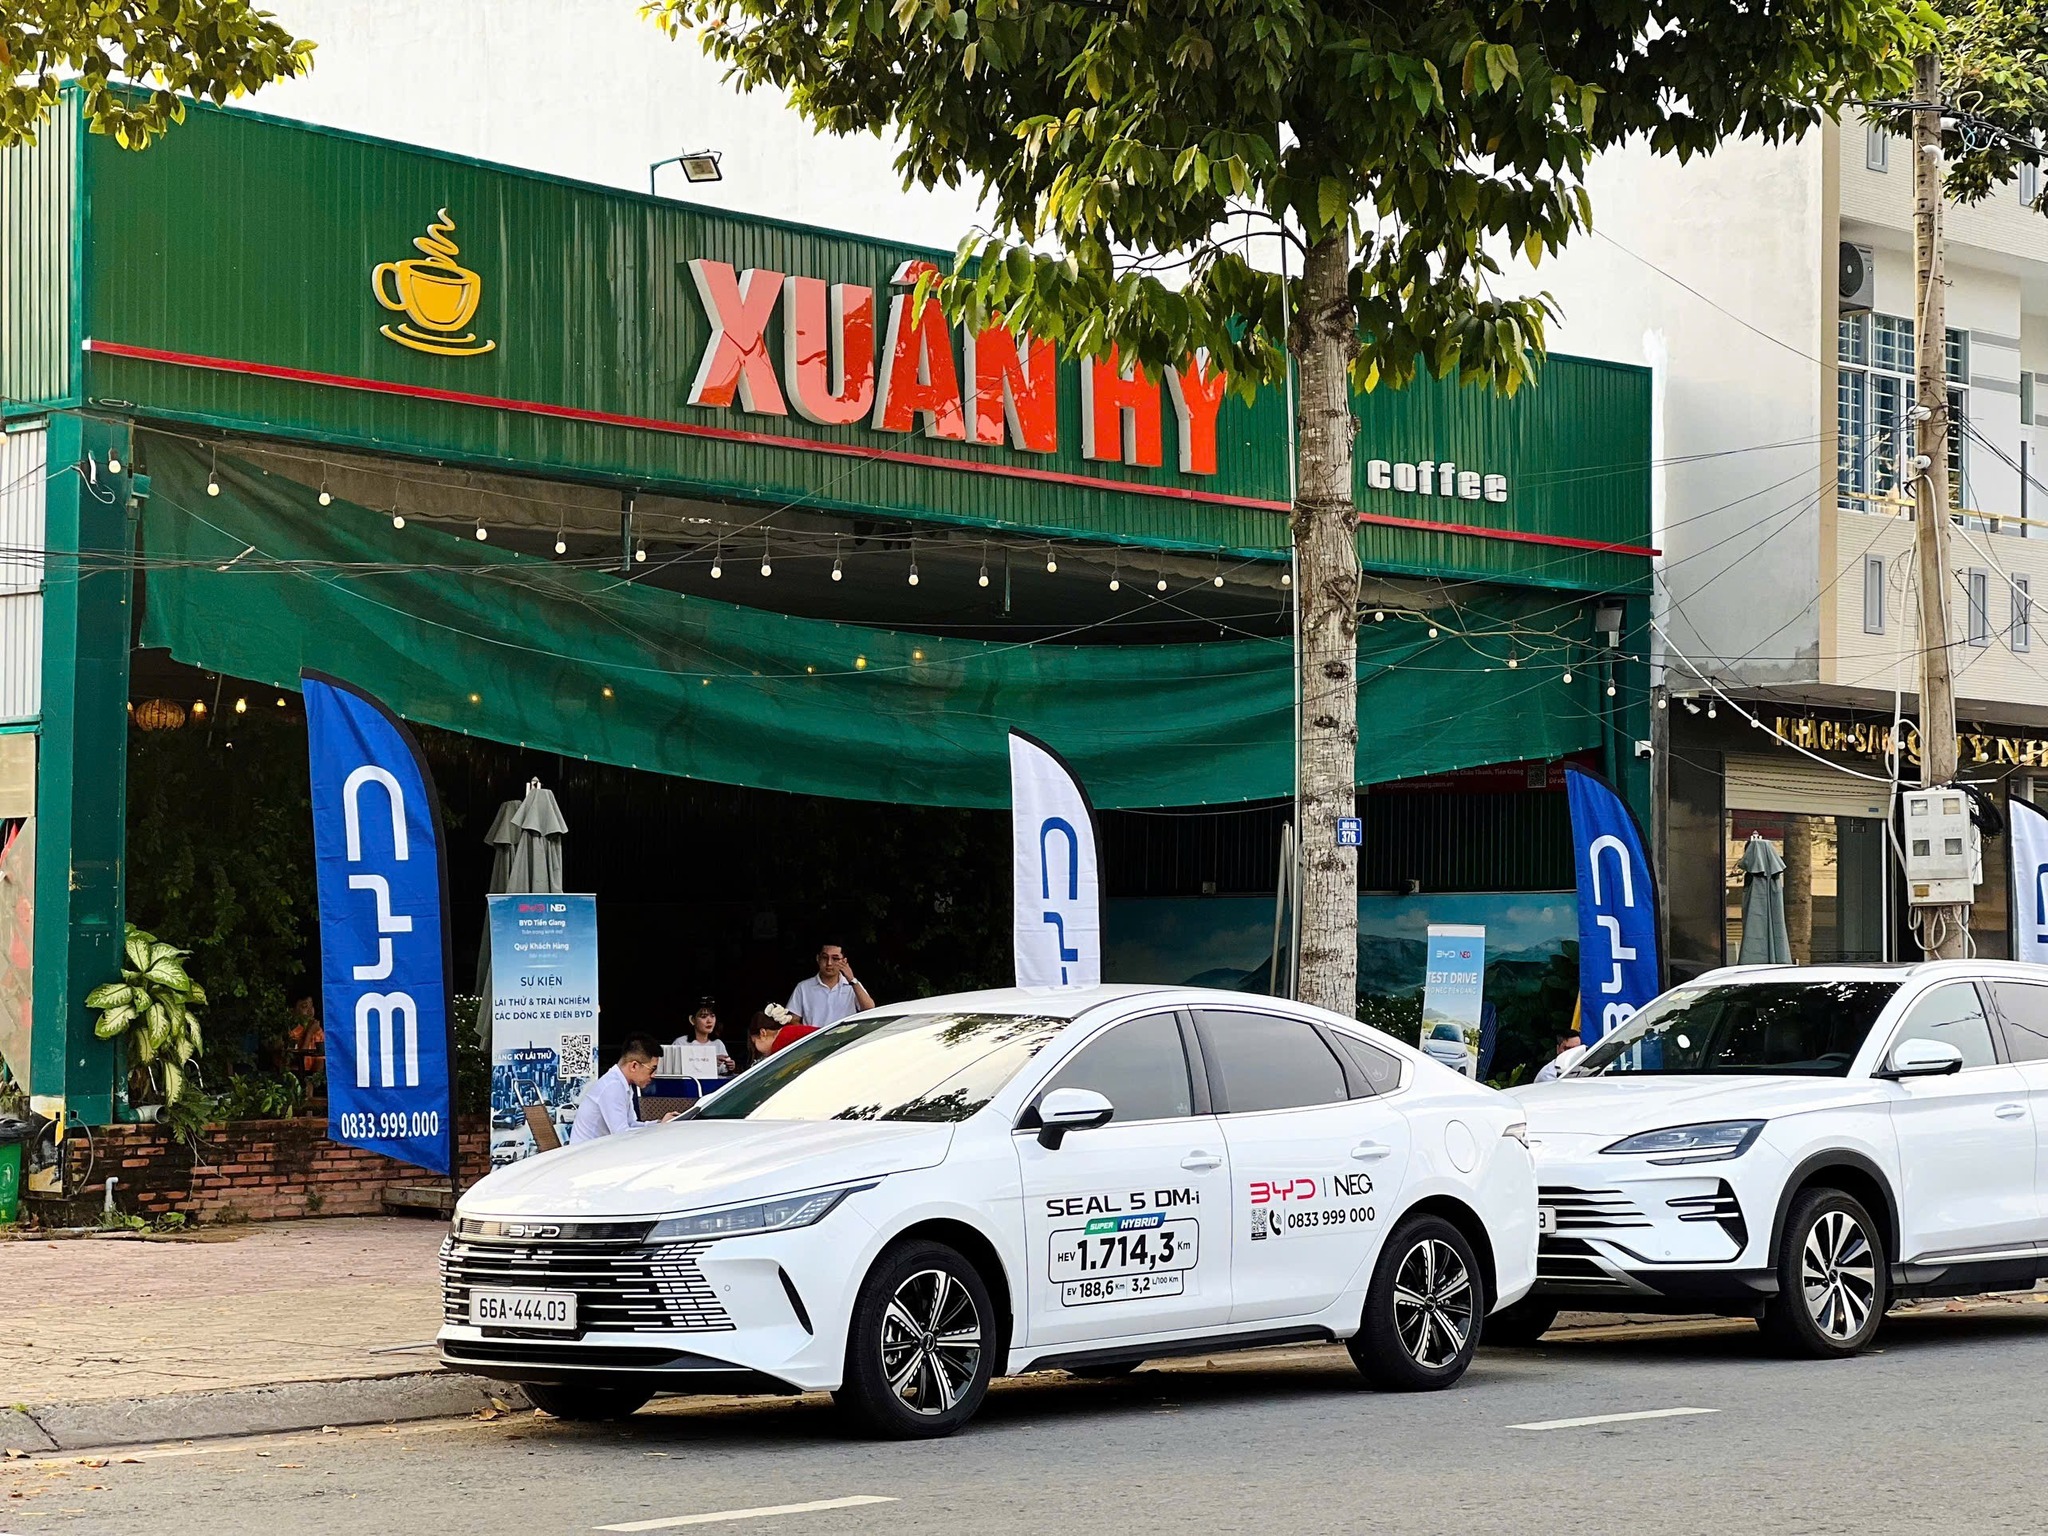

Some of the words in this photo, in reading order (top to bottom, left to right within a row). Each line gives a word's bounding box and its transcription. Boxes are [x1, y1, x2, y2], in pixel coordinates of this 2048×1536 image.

[687, 259, 1057, 454] XUÂN
[1367, 459, 1507, 502] coffee
[1341, 830, 1357, 843] 376
[1040, 816, 1078, 985] YD
[343, 765, 420, 1087] BYD
[518, 919, 533, 927] BYD
[548, 919, 566, 928] Giang
[529, 942, 551, 951] Khách
[552, 942, 569, 951] Hàng
[1436, 950, 1456, 959] BYD
[520, 975, 534, 989] SỰ
[537, 974, 563, 989] KIỆN
[1427, 972, 1449, 984] TEST
[1450, 972, 1478, 984] DRIVE
[508, 996, 527, 1006] THỬ
[528, 998, 535, 1006] &
[536, 995, 556, 1006] TRẢI
[558, 996, 590, 1007] NGHIỆM
[494, 1011, 511, 1020] CÁC
[513, 1009, 538, 1020] DÒNG
[539, 1011, 551, 1019] XE
[553, 1009, 573, 1020] ĐIỆN
[574, 1010, 593, 1019] BYD
[525, 1051, 536, 1060] LÁI
[537, 1050, 553, 1060] THỬ
[341, 1110, 438, 1140] 0833.999.000
[1249, 1178, 1316, 1204] BYD
[1046, 1195, 1122, 1217] SEAL
[1130, 1192, 1146, 1210] 5
[1089, 1221, 1114, 1231] SUPER
[1120, 1216, 1159, 1229] HYBRID
[1287, 1211, 1319, 1229] 0833
[1322, 1208, 1346, 1226] 999
[1349, 1206, 1376, 1223] 000
[508, 1223, 561, 1239] BYD
[1057, 1251, 1076, 1262] HEV
[1077, 1231, 1175, 1271] 1.714,3
[1177, 1241, 1191, 1250] Km
[1067, 1287, 1077, 1296] EV
[1079, 1280, 1114, 1299] 188,6
[1131, 1277, 1150, 1294] 3,2
[1152, 1277, 1168, 1285] L/100
